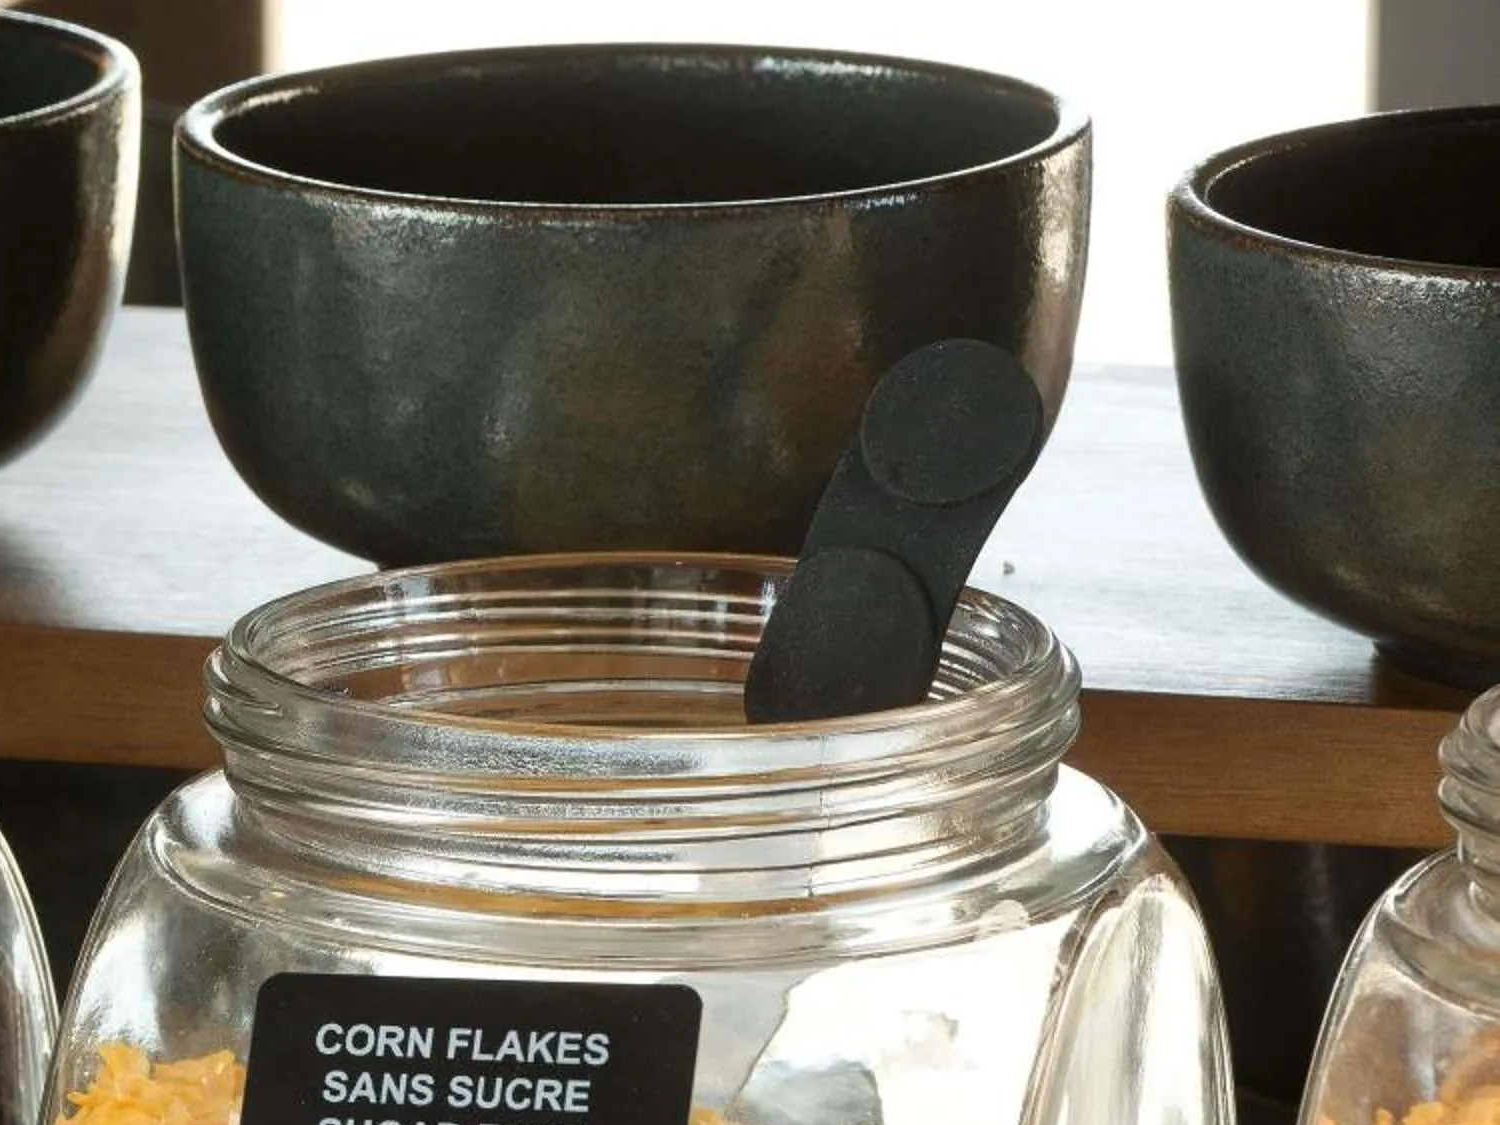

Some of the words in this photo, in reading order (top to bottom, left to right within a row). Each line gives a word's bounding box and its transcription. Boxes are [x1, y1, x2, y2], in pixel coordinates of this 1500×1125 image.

[315, 1023, 434, 1059] CORN
[446, 1027, 610, 1066] FLAKES
[323, 1070, 435, 1106] SANS
[447, 1075, 591, 1113] SUCRE
